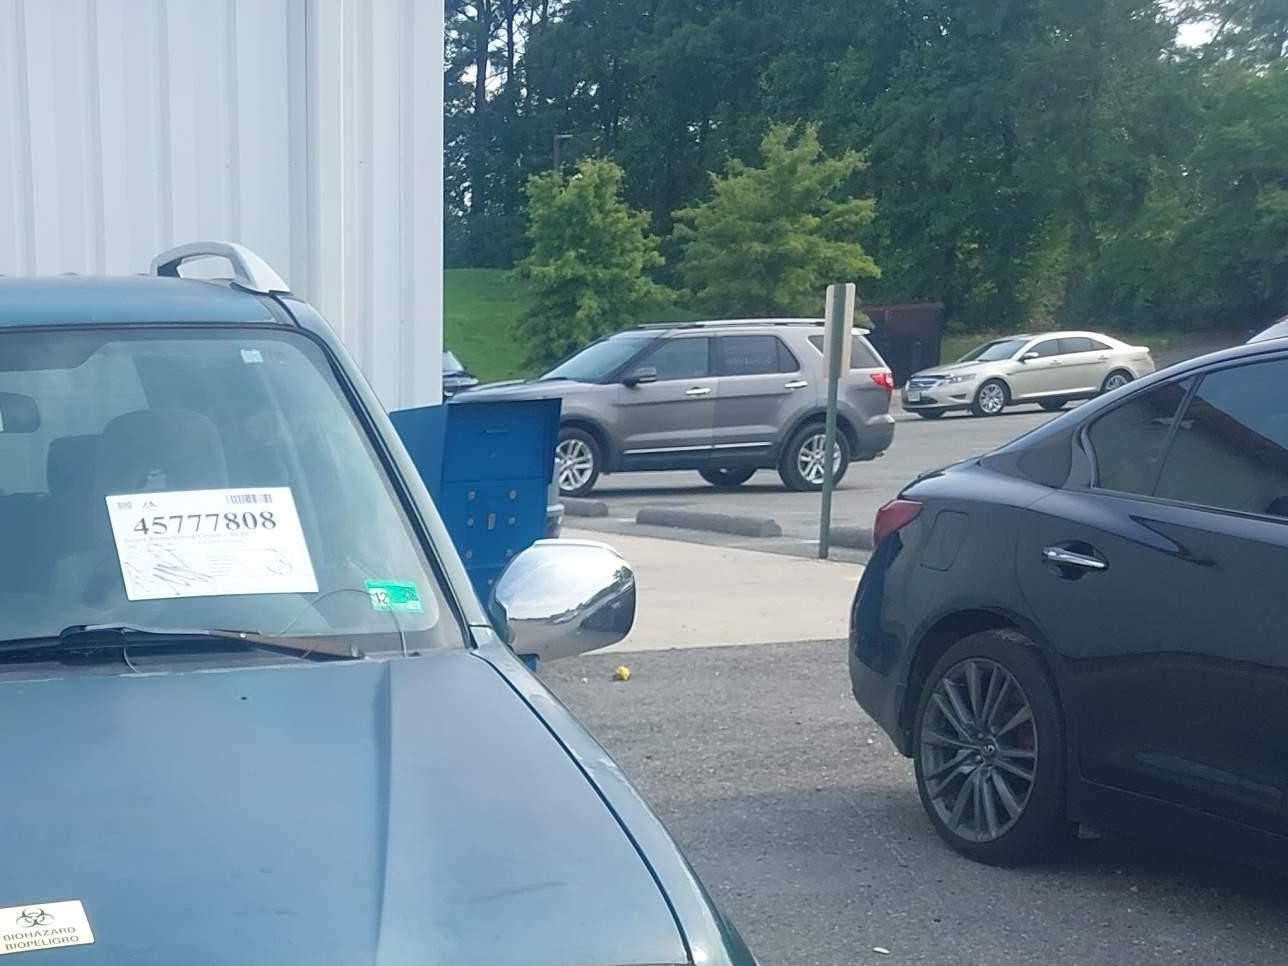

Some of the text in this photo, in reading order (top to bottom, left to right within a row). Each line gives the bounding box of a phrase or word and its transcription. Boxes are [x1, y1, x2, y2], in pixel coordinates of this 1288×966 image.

[133, 511, 277, 535] 45777808
[2, 926, 76, 942] BIOHAZARD
[5, 935, 79, 951] BIOPELIGRO
